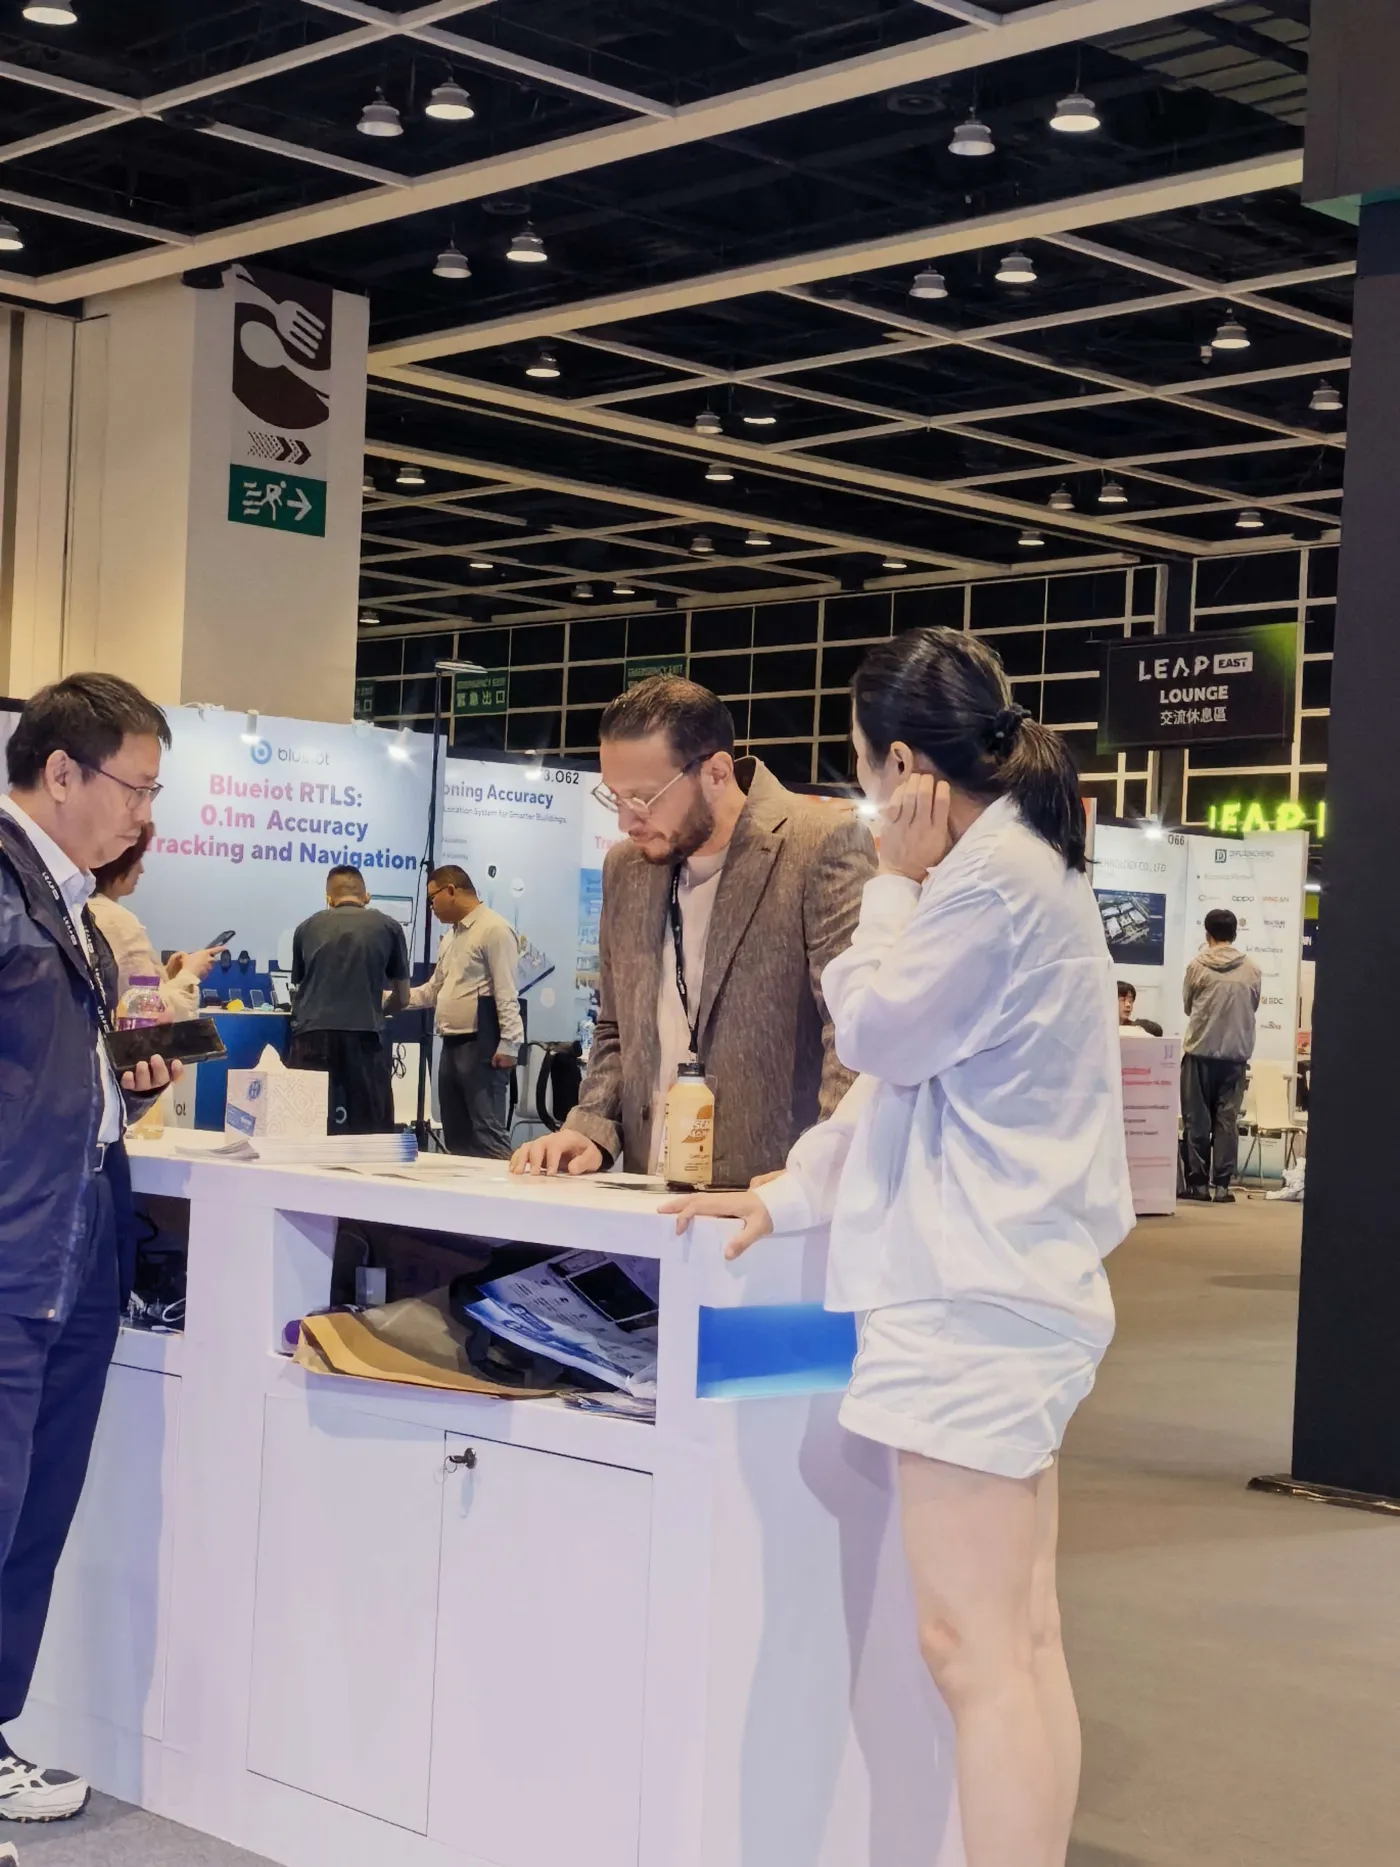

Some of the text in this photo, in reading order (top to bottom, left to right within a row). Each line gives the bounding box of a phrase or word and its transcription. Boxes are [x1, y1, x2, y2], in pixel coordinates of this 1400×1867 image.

[1138, 656, 1248, 682] LEAP EAST
[1159, 686, 1228, 704] LOUNGE
[1160, 707, 1227, 726] 交流休息區
[278, 748, 330, 766] blueot
[209, 774, 363, 807] Blueiot RTLS:
[487, 784, 554, 809] Accuracy
[200, 804, 368, 842] 0.1m Accuracy
[251, 841, 292, 862] and
[300, 842, 417, 870] Navigation
